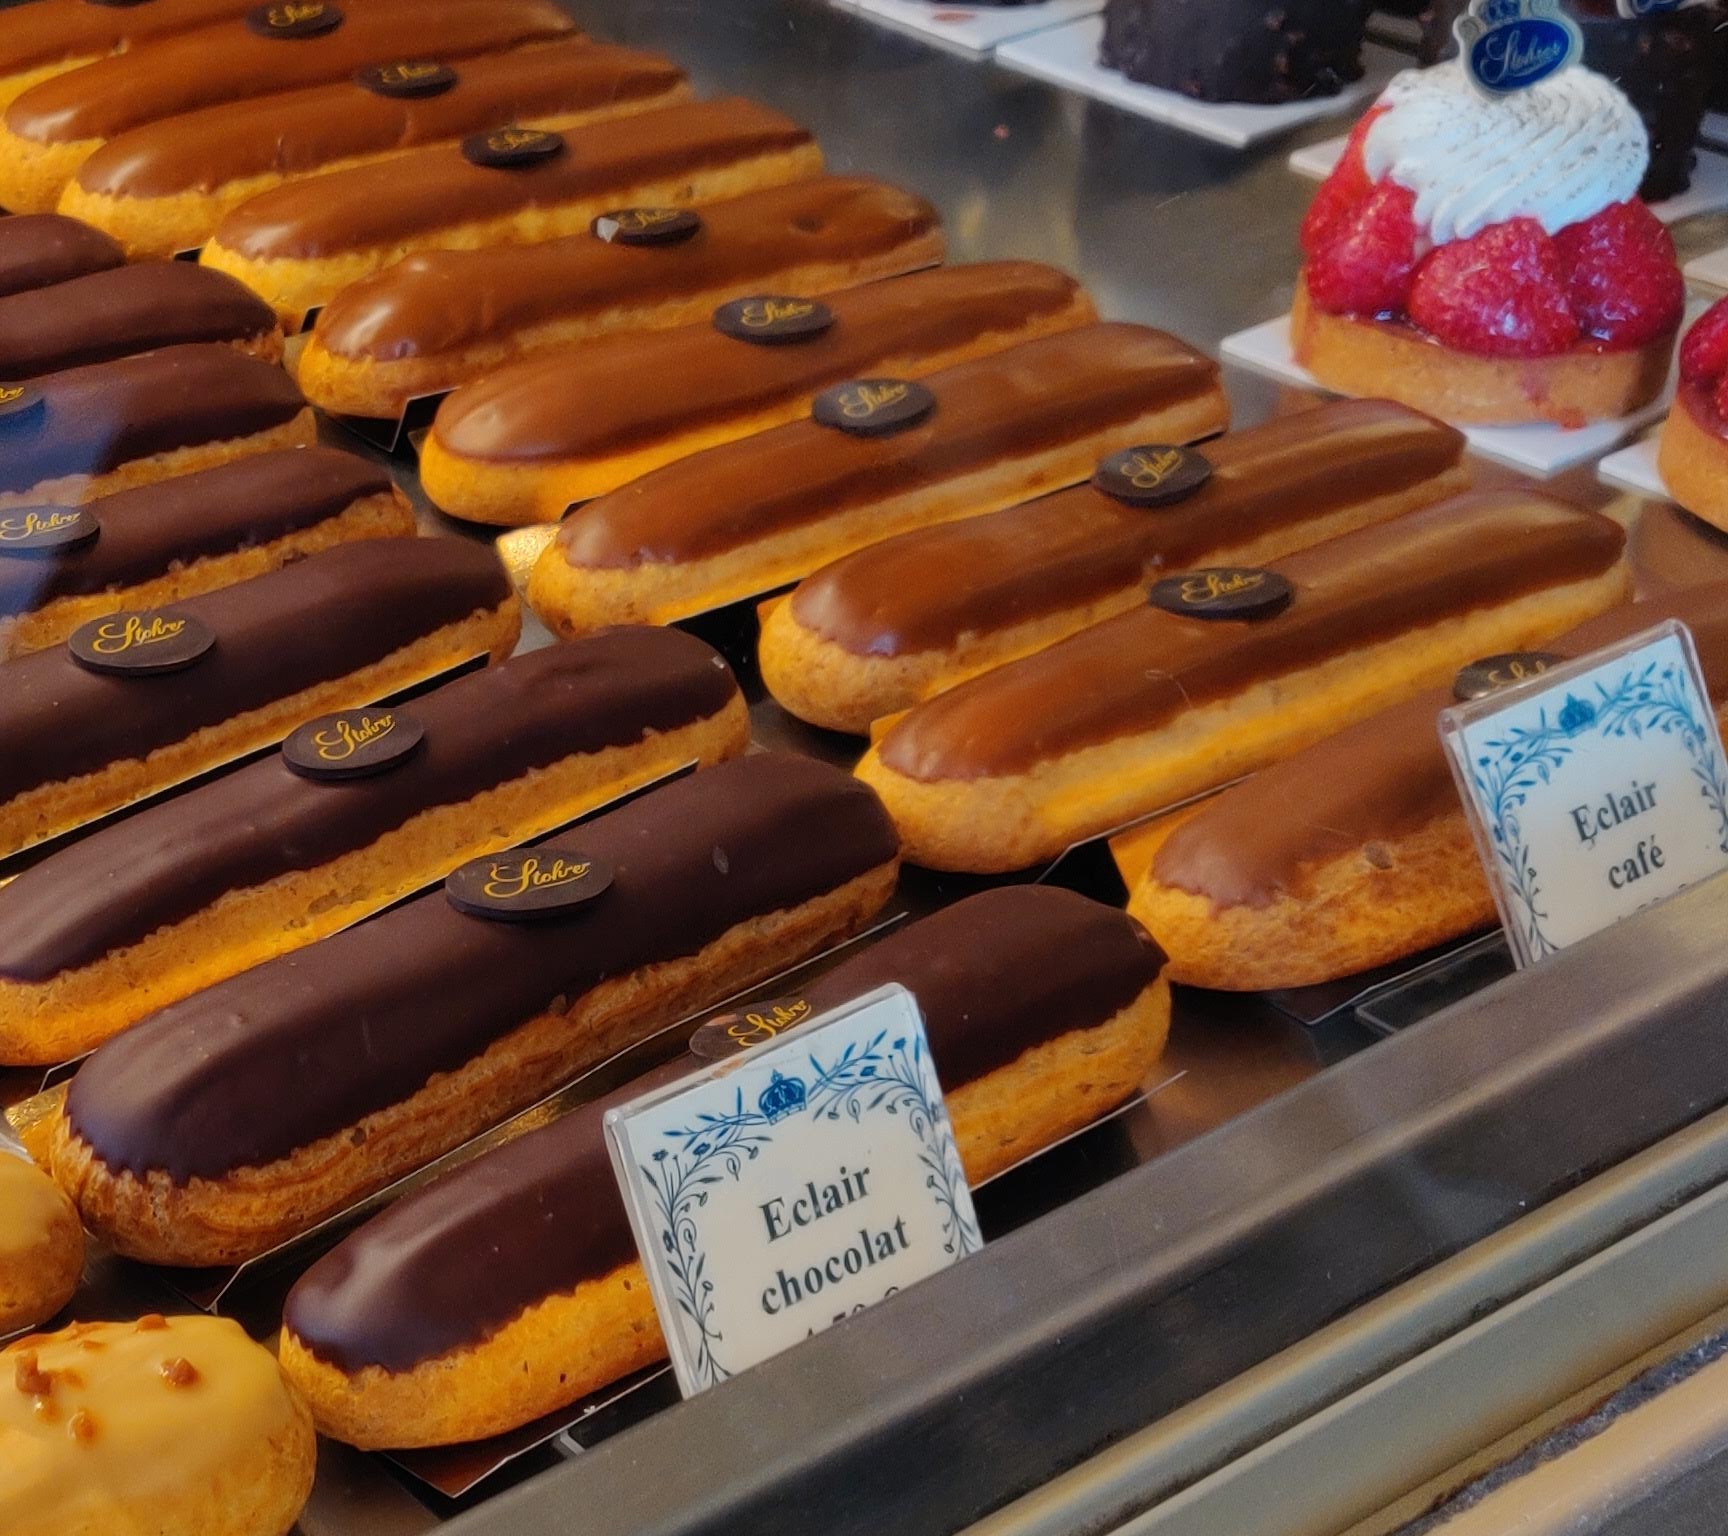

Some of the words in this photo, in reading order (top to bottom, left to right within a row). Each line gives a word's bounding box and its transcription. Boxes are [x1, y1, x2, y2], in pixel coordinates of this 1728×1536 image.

[92, 612, 186, 655] Stohrer
[312, 712, 397, 761] Stohrer
[1569, 780, 1656, 841] Eclair
[483, 857, 592, 900] Stohrer
[1608, 834, 1665, 889] café
[758, 1166, 870, 1244] Eclair
[762, 1215, 910, 1315] chocolat
